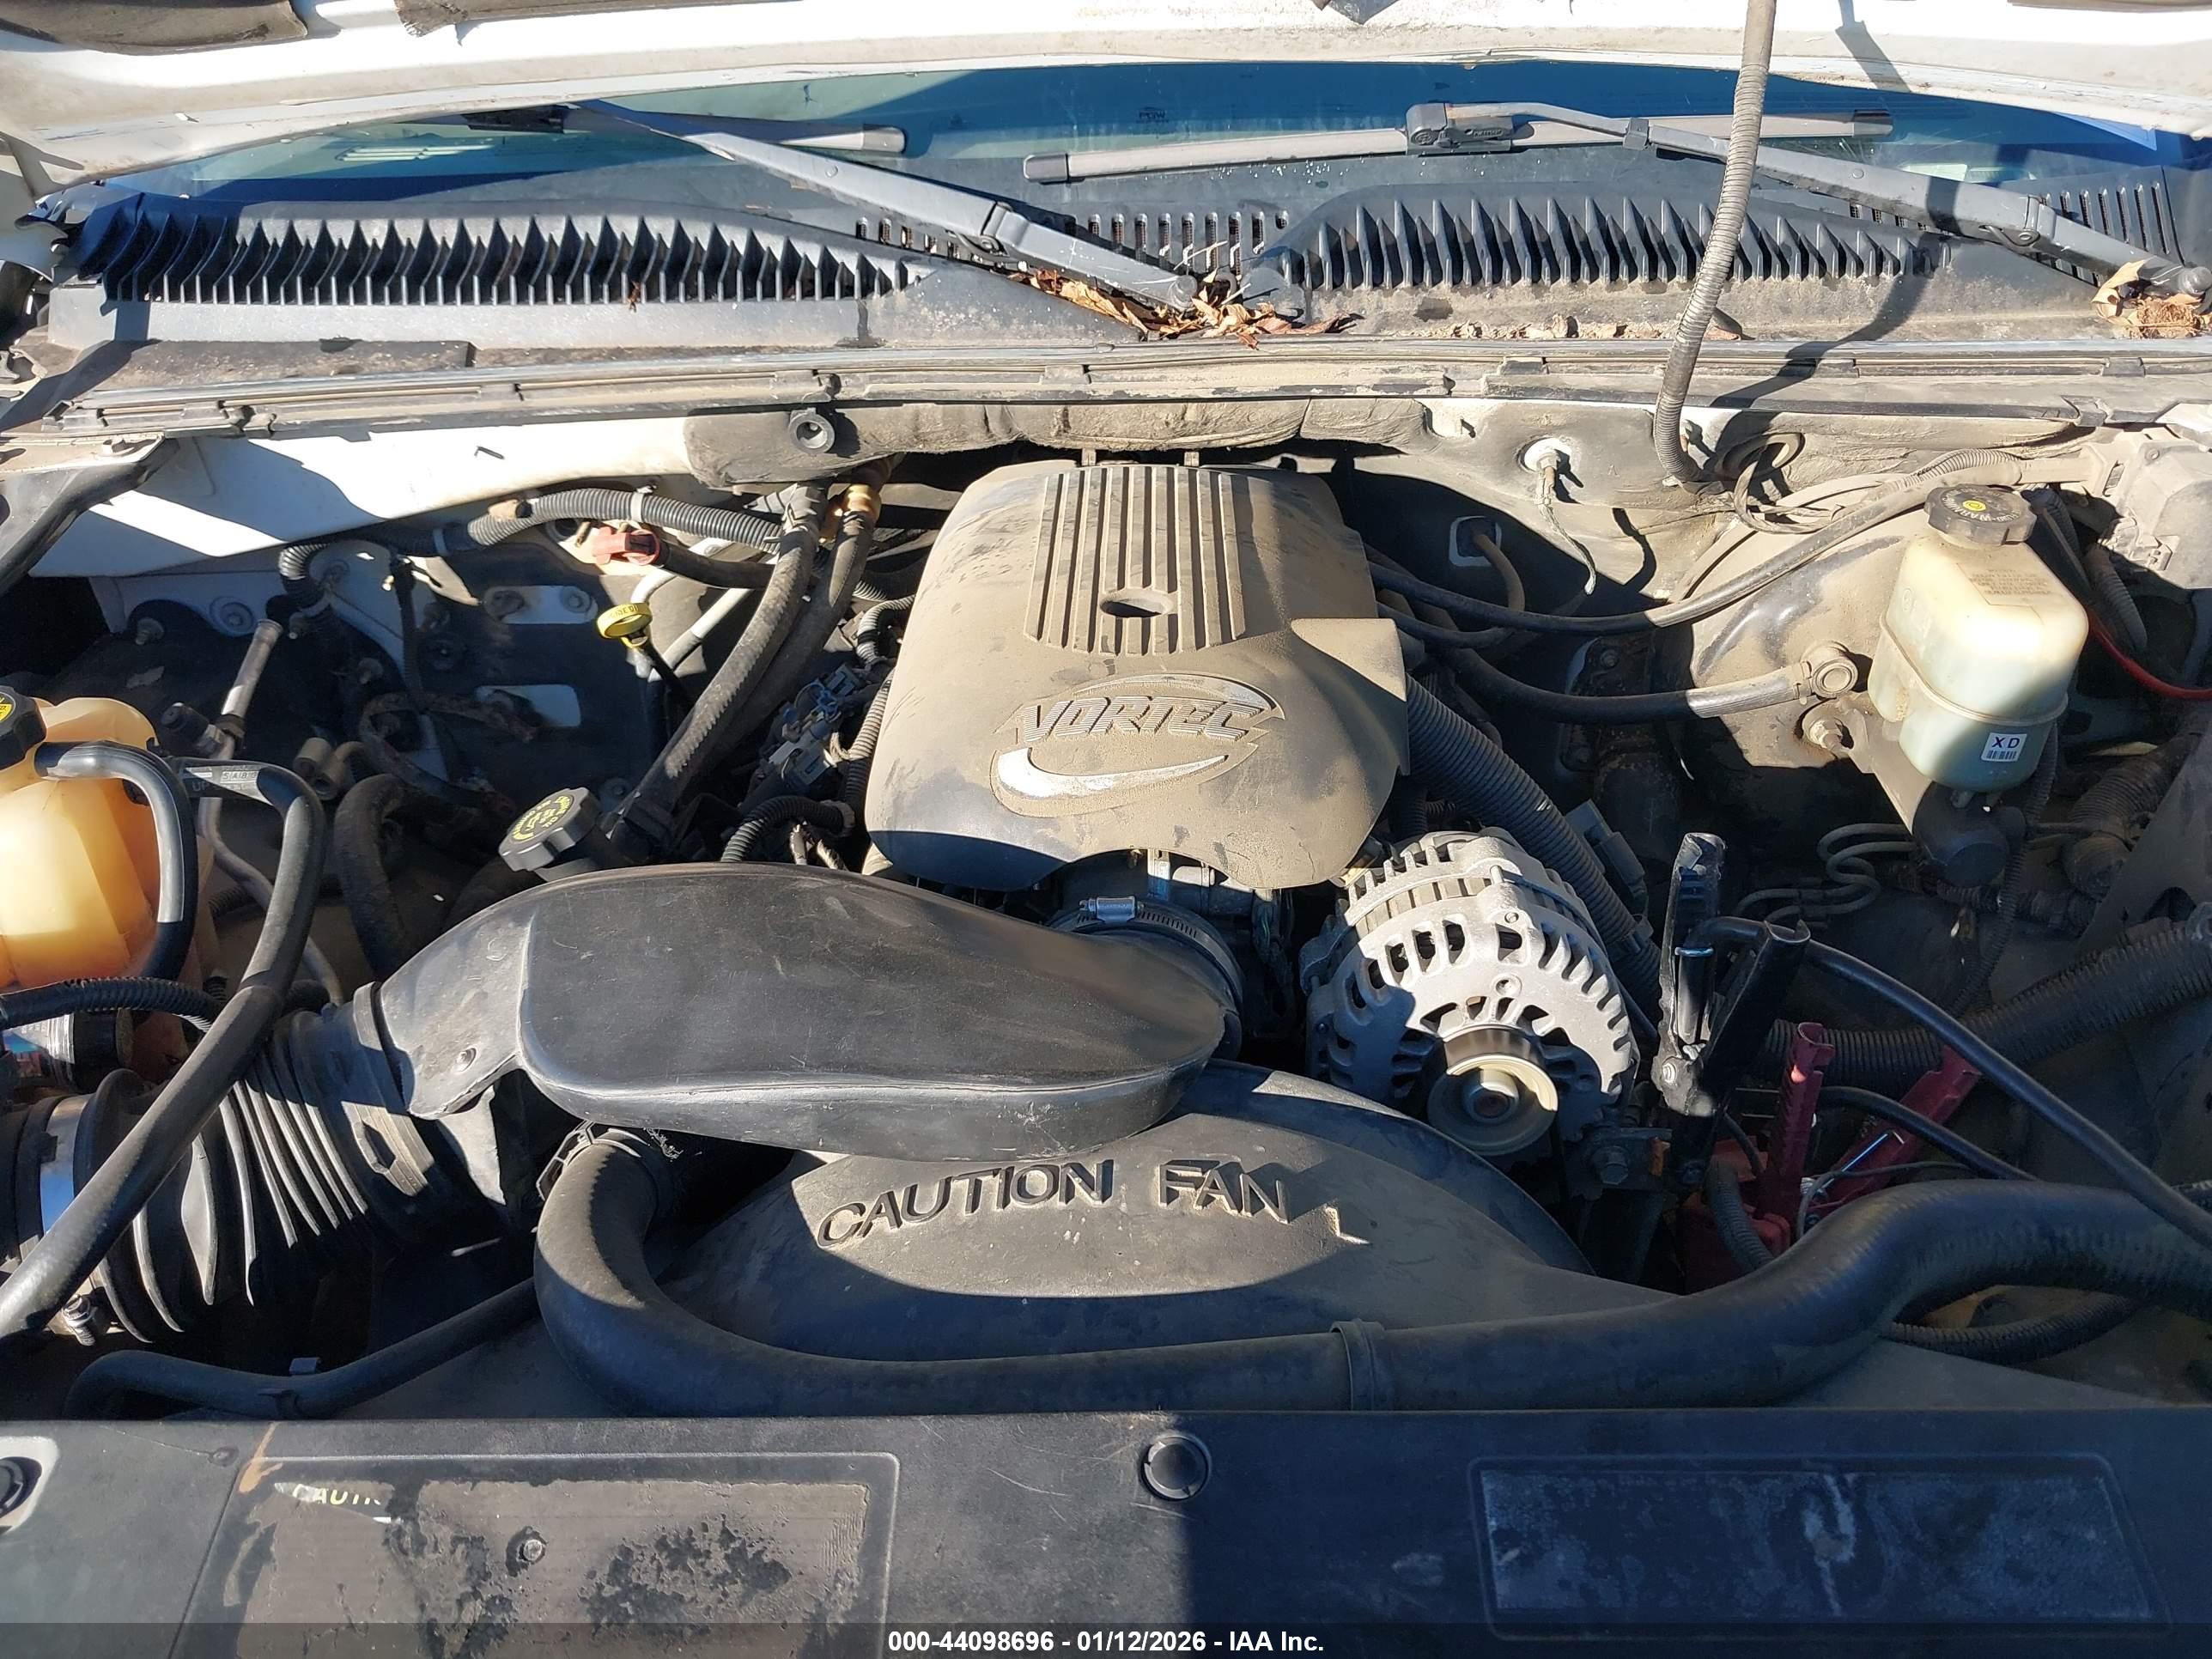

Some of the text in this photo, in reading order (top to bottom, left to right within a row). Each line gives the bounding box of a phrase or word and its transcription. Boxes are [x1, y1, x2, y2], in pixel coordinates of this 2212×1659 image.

[1016, 695, 1267, 742] VORTEC
[817, 1158, 1290, 1248] CAUTION FAN
